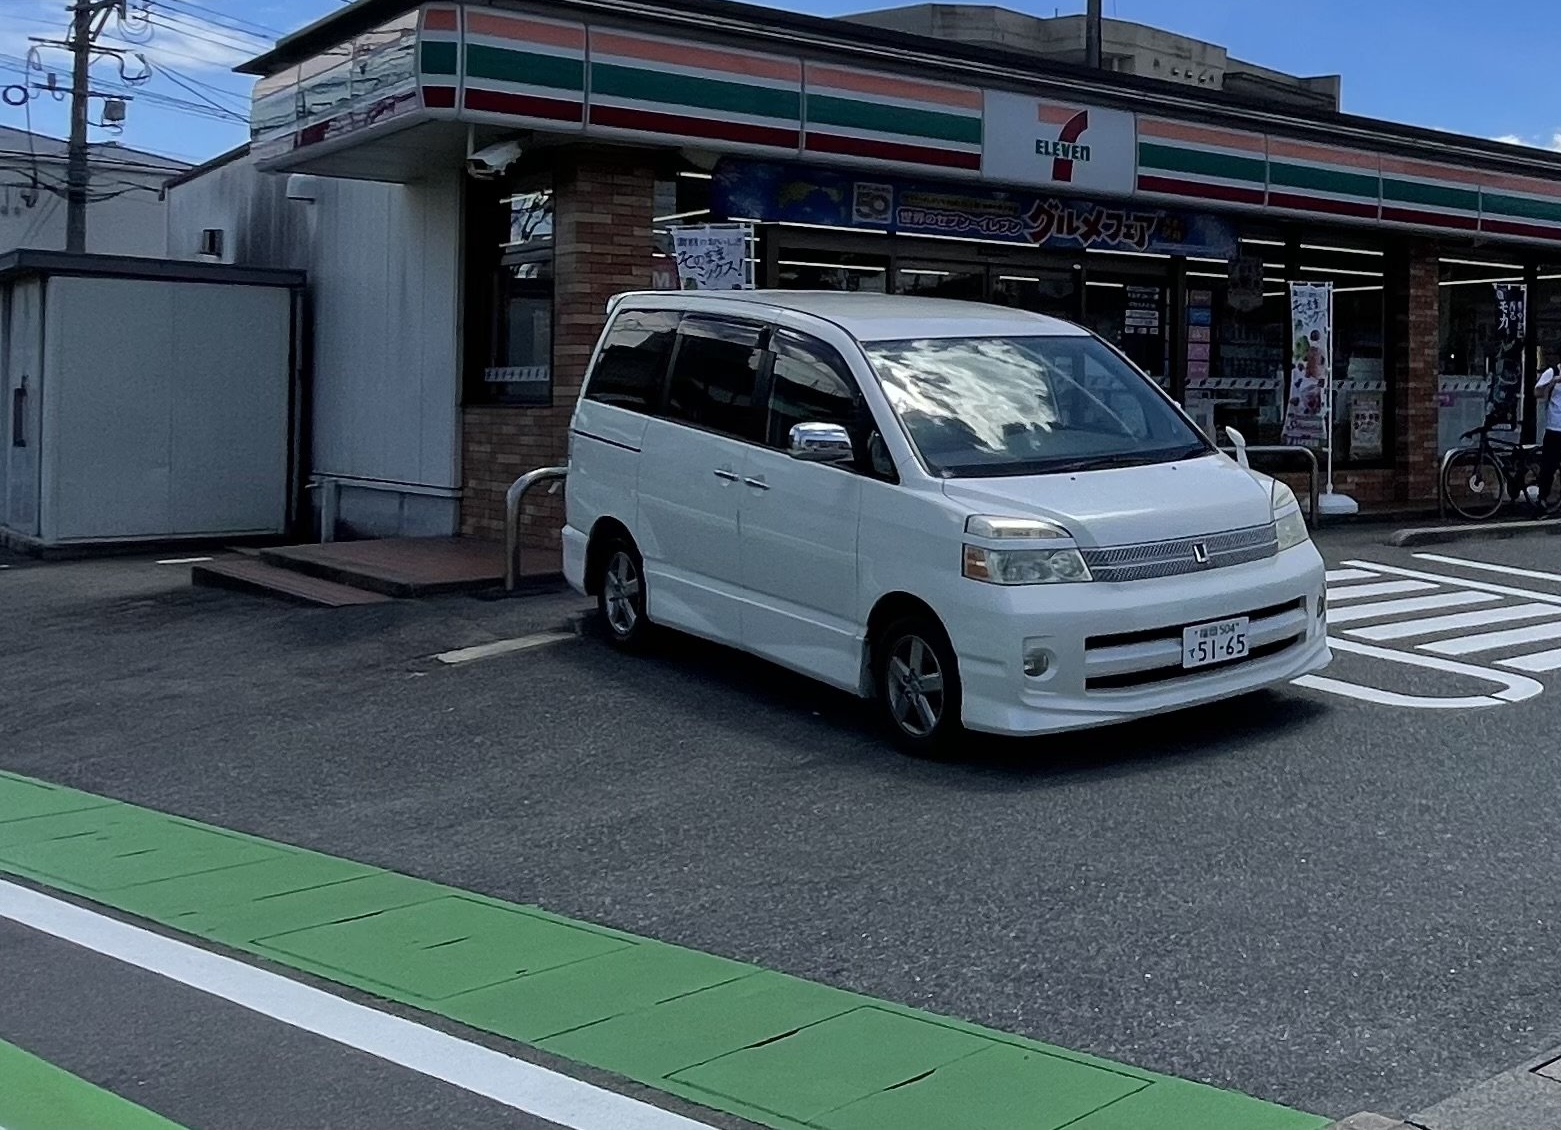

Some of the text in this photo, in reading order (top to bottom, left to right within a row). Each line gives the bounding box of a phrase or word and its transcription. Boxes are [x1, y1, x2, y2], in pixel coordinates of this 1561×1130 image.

[1025, 198, 1160, 252] グルメフェア
[1198, 634, 1246, 662] 51-65
